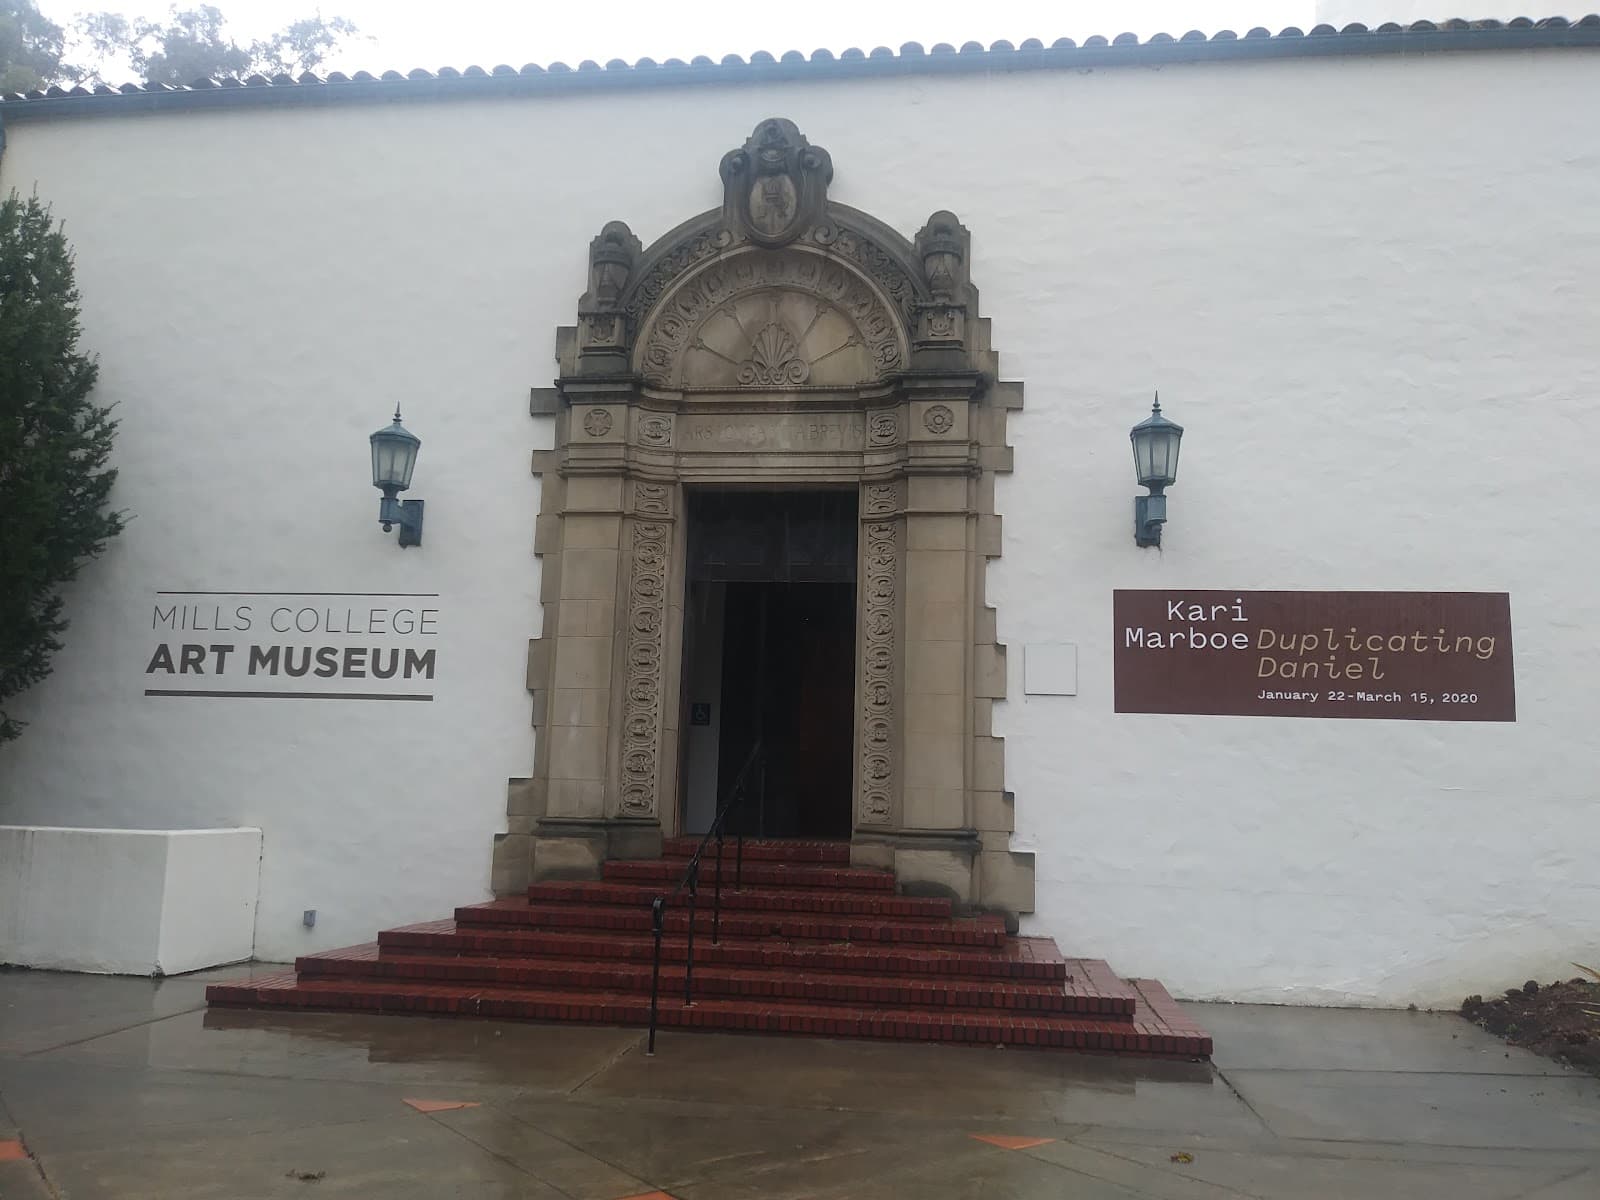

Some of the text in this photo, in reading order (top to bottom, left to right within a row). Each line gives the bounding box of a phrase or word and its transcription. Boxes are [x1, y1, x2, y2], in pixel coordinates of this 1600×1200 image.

[152, 604, 440, 635] MILLS COLLEGE
[1167, 597, 1249, 622] Kari
[1125, 626, 1249, 650] Marboe
[1257, 627, 1496, 660] Duplicating
[145, 643, 436, 680] ART MUSEUM
[1257, 654, 1385, 680] Daniel
[1257, 689, 1479, 705] January 22-March 15, 2020
